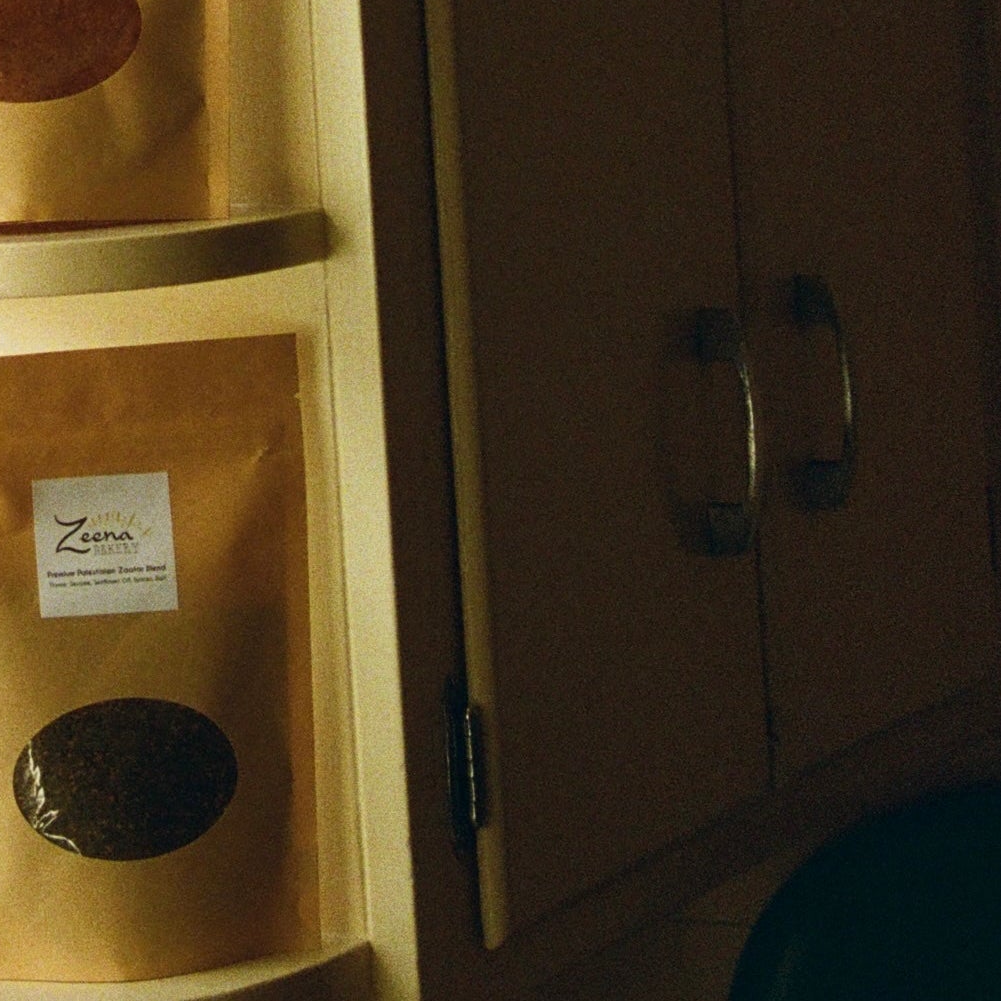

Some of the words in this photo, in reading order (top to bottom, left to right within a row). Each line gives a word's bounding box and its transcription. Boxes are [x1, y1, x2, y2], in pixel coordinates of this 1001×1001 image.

[54, 515, 134, 553] Zeena
[94, 541, 139, 556] BAKERY
[47, 570, 75, 578] Premium
[146, 564, 167, 572] Blend
